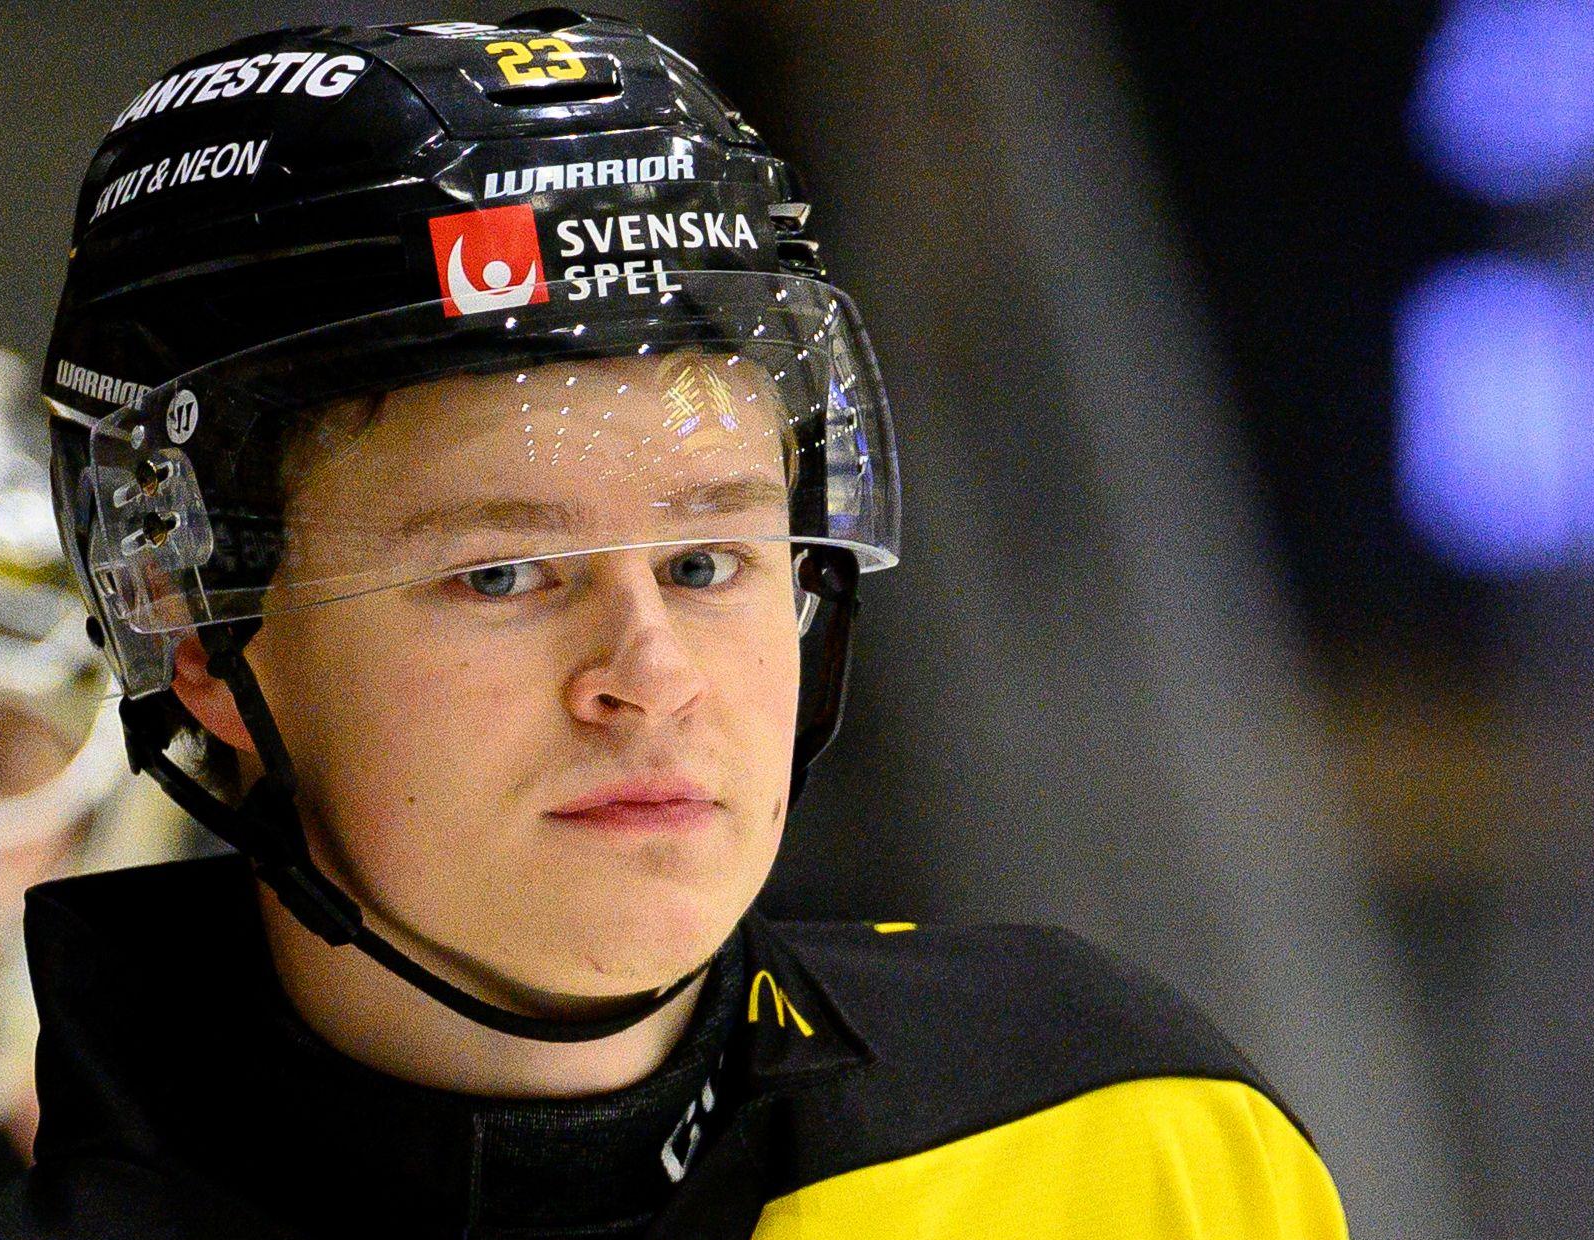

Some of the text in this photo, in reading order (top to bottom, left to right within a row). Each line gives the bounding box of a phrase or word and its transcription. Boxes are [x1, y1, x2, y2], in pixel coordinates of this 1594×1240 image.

[485, 38, 587, 85] 23
[89, 139, 268, 224] SKYLT & NEON
[484, 154, 695, 199] WARRIOR
[557, 211, 758, 257] SVENSKA
[564, 259, 682, 301] SPEL
